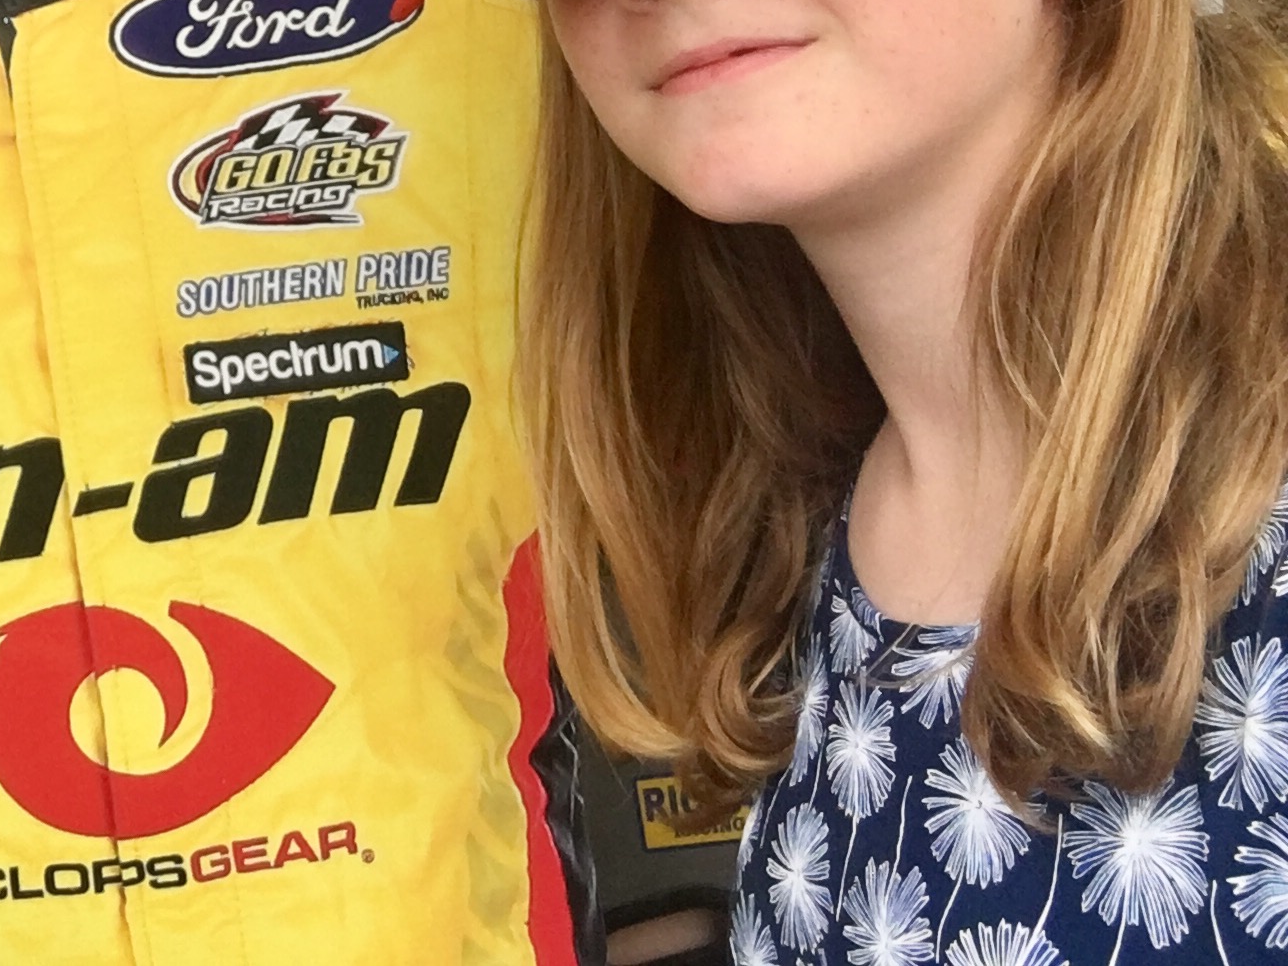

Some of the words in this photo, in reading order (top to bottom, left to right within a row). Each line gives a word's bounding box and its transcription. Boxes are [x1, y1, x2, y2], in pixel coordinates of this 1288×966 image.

[177, 259, 346, 318] SOUTHERN
[355, 246, 451, 293] PRIDE
[192, 340, 383, 393] Spectrum
